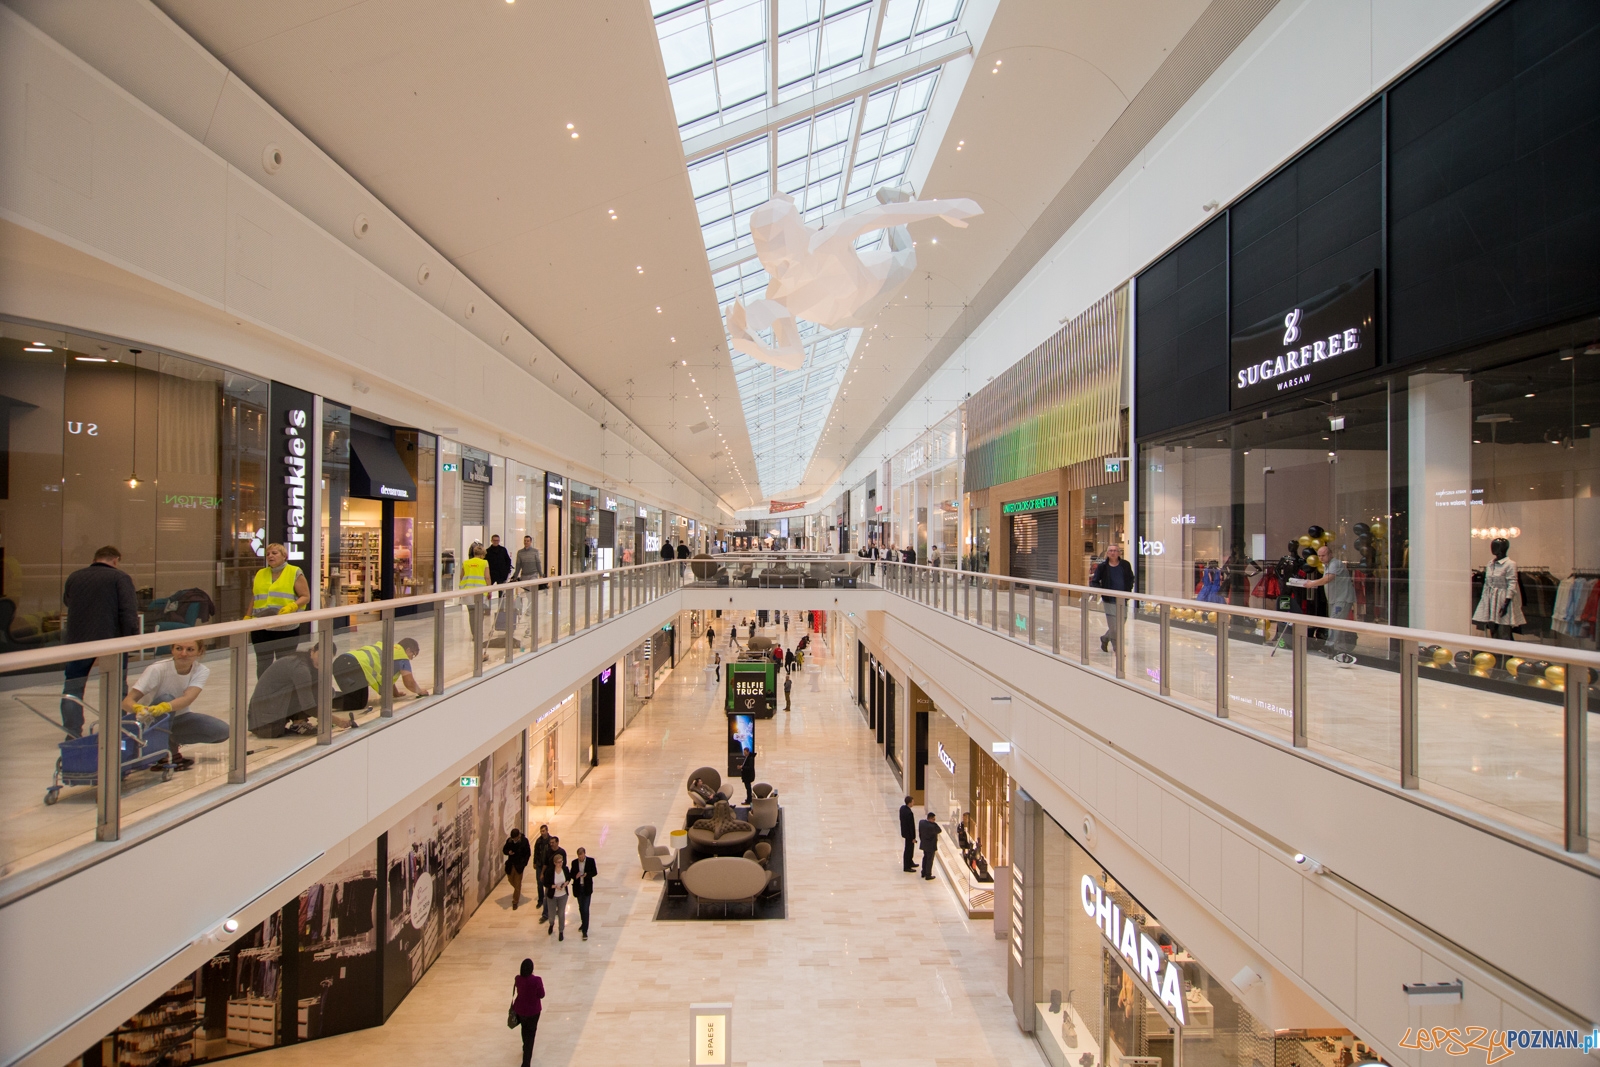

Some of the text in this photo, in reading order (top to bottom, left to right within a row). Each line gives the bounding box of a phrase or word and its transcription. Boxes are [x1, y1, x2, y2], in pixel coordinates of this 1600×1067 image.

[1238, 328, 1359, 388] SUGARFREE
[1277, 374, 1311, 391] WARSAW
[285, 410, 306, 561] Frankie's
[736, 681, 764, 689] SELFIE
[736, 688, 764, 696] TRUCK
[938, 741, 955, 774] Kazar
[1080, 874, 1187, 1026] CHIARA
